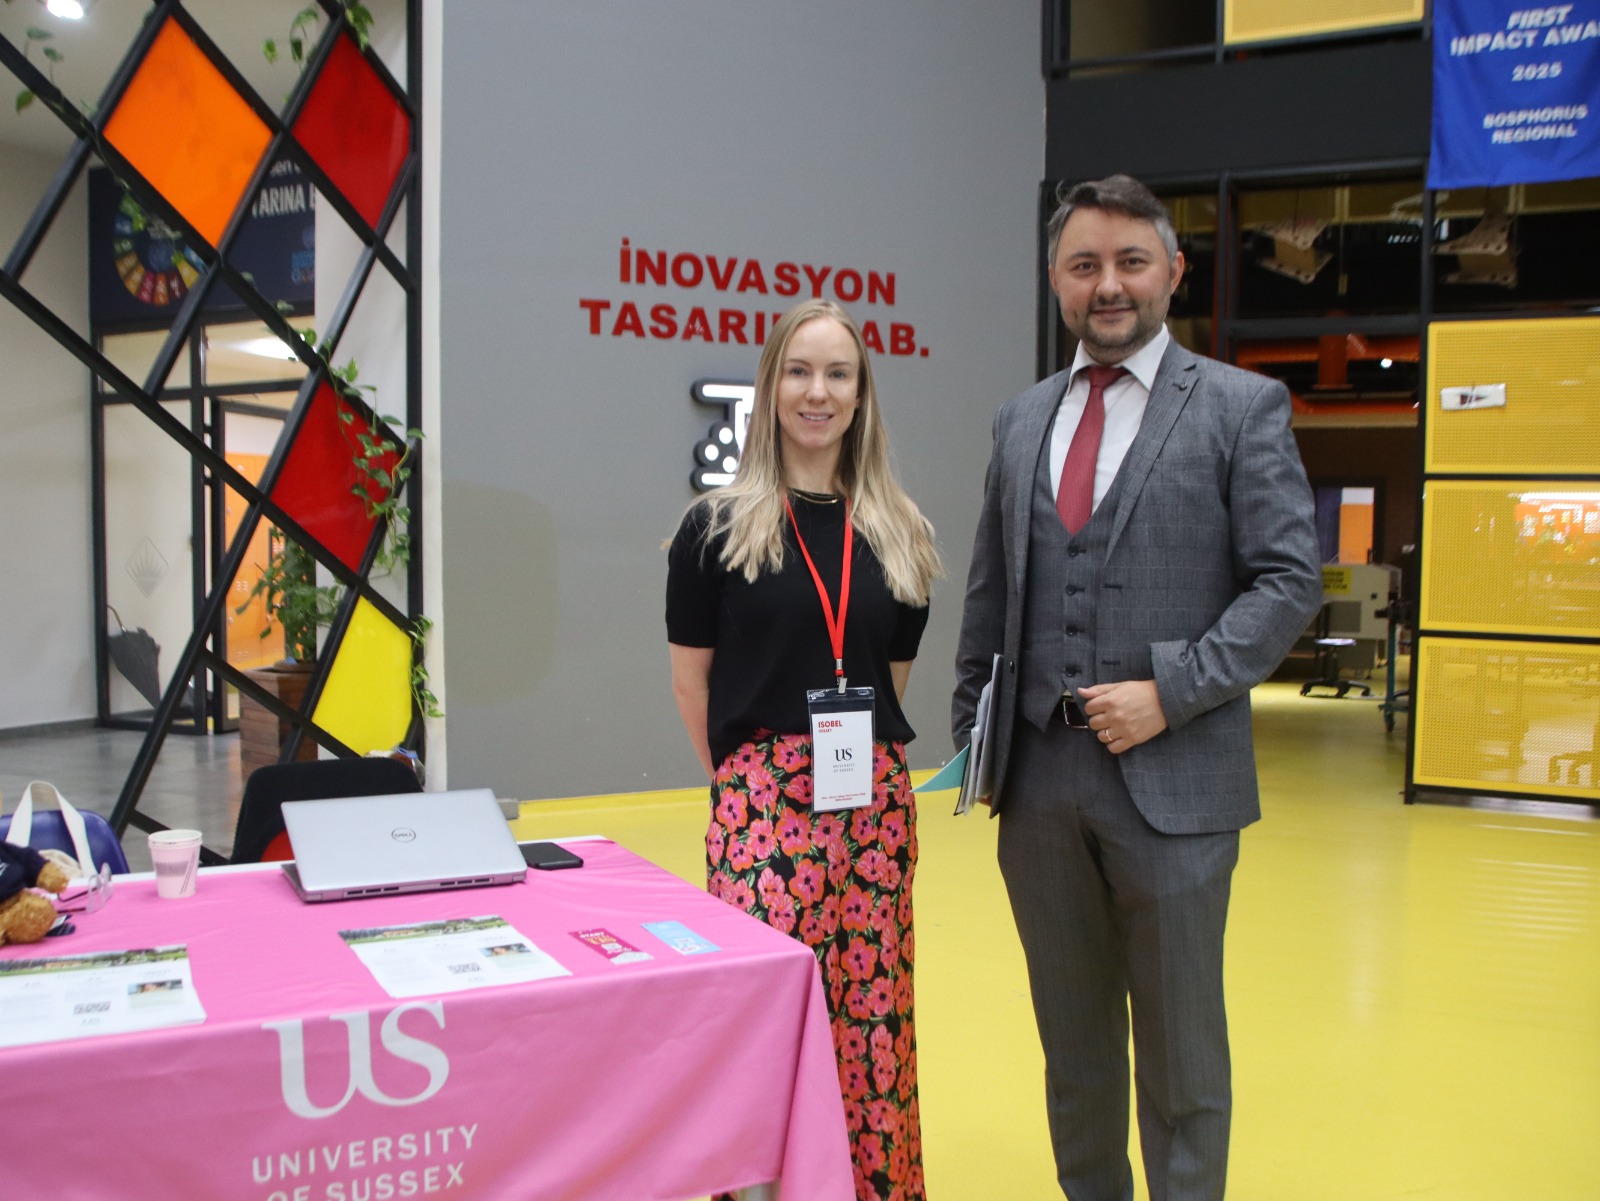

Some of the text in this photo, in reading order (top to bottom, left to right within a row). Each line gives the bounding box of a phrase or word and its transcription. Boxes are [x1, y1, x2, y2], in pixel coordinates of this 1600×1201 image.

[1506, 5, 1573, 30] FIRST
[1450, 20, 1600, 56] IMPACT AWA
[1511, 61, 1562, 82] 2025
[1483, 104, 1588, 129] BOSPHORUS
[1491, 123, 1577, 144] REGIONAL
[620, 238, 896, 305] İNOVASYON
[580, 299, 930, 357] TASARI AB.
[818, 720, 843, 728] ISOBEL
[252, 1123, 478, 1183] UNIVERSITY
[326, 1162, 464, 1201] SUSSEX
